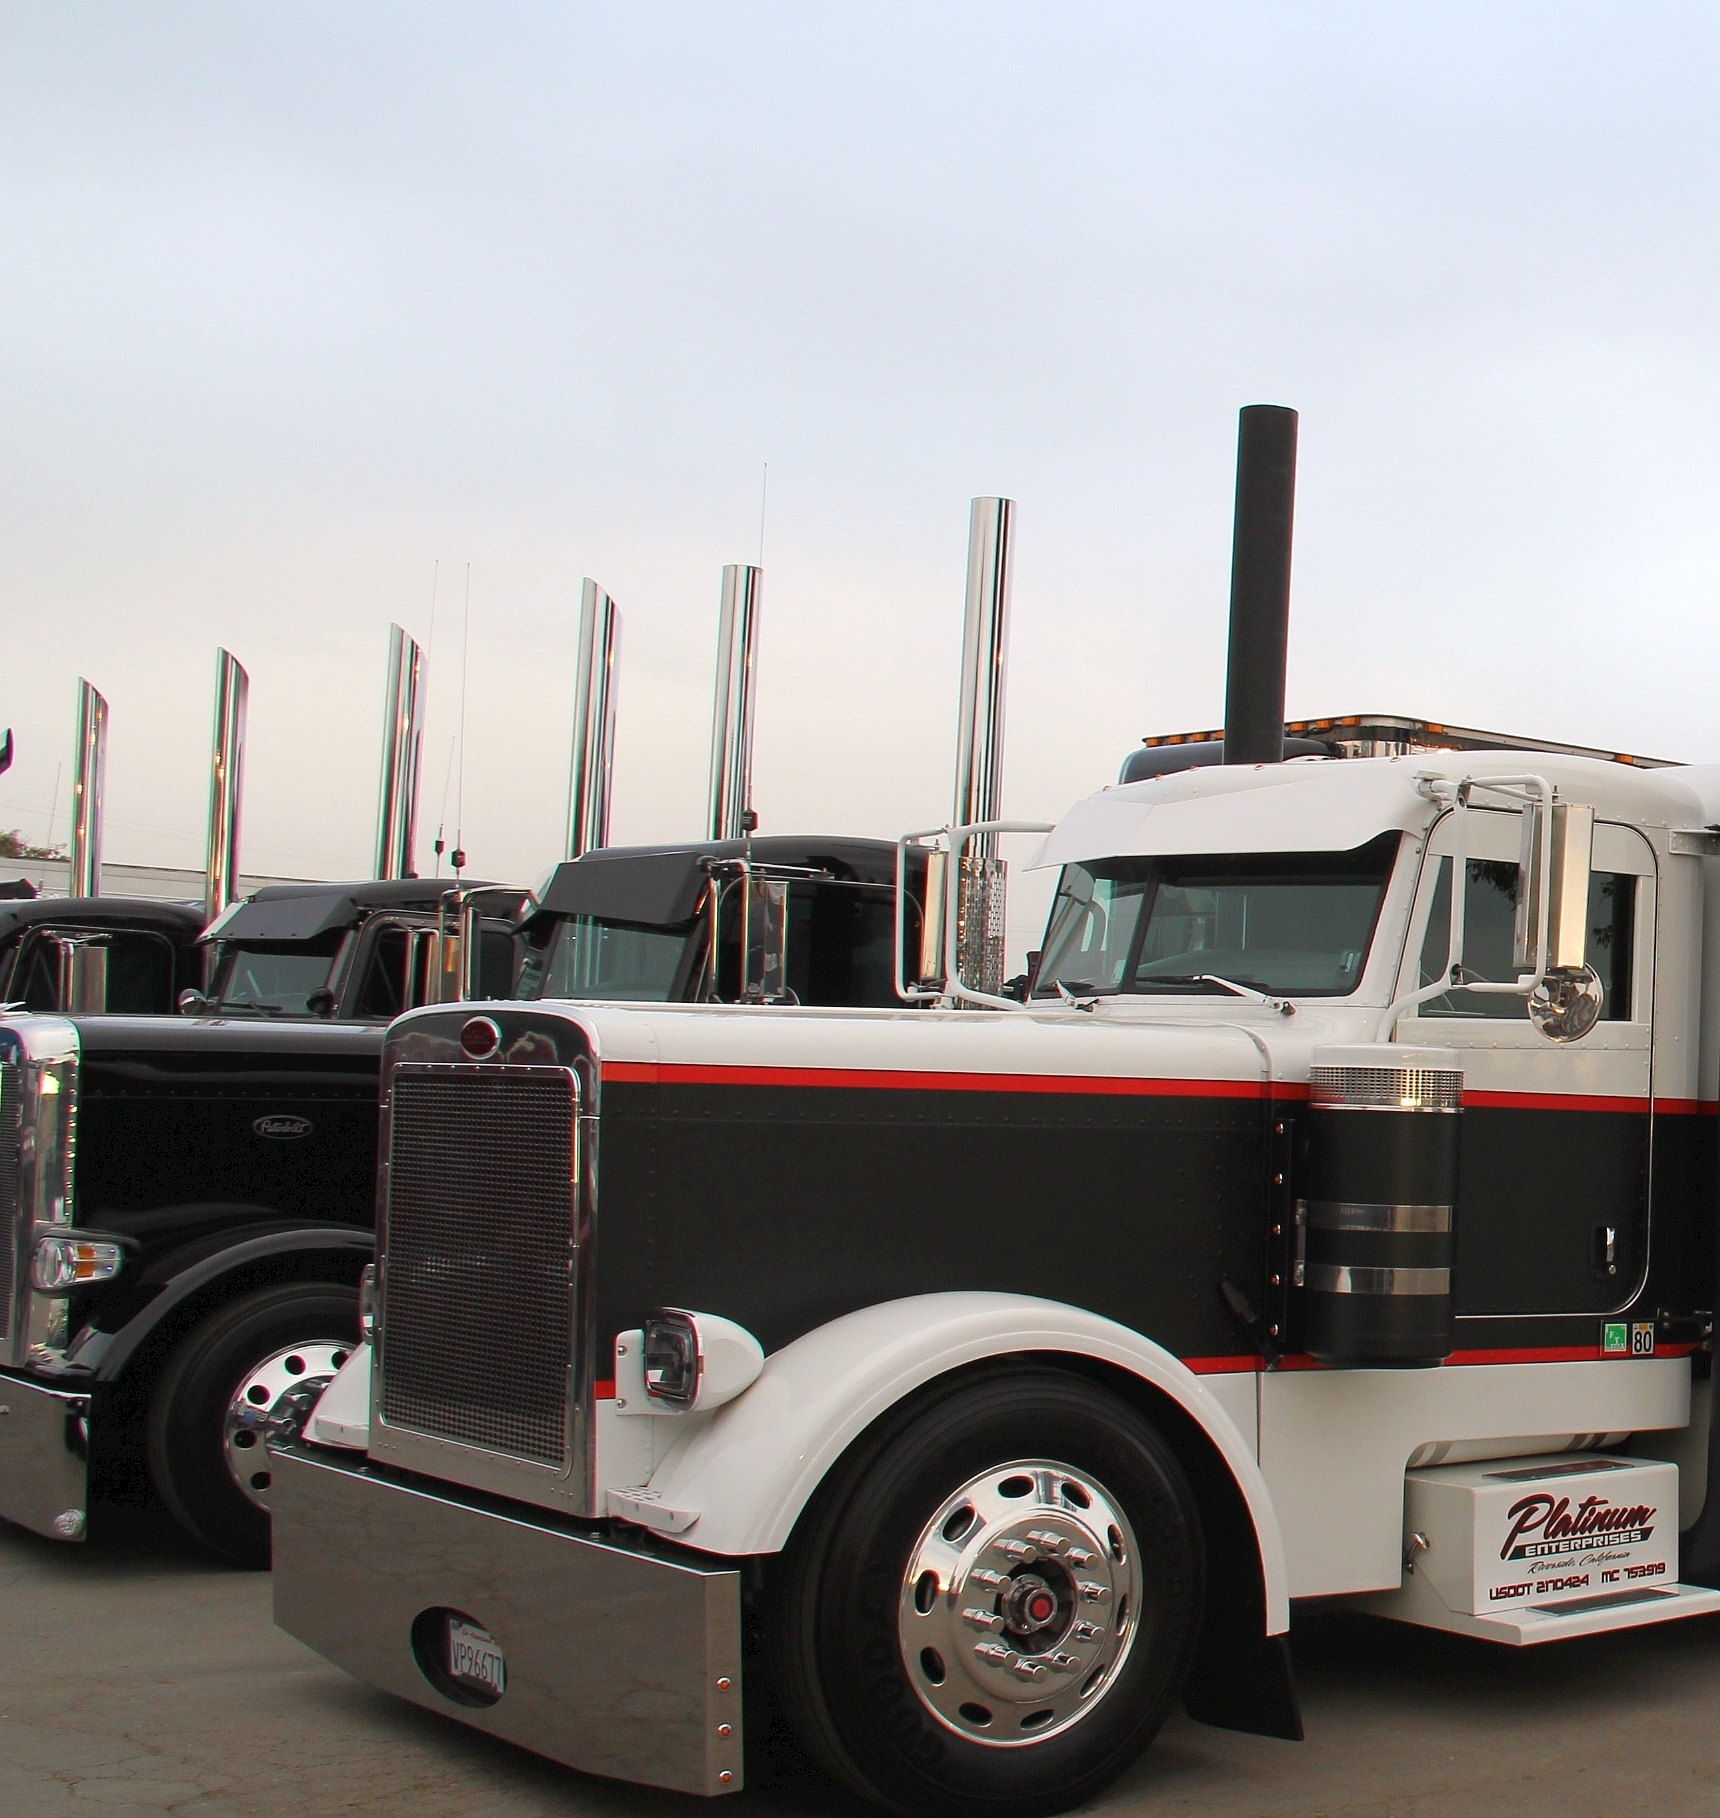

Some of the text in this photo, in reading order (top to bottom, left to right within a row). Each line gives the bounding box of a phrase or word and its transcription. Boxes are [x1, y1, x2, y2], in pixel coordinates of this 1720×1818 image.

[1634, 1331, 1652, 1353] 80
[1500, 1493, 1657, 1560] Platinum
[1525, 1530, 1641, 1557] ENTERPRISES
[1579, 1550, 1631, 1567] California
[1489, 1582, 1534, 1601] USDOT
[1601, 1568, 1620, 1584] MC
